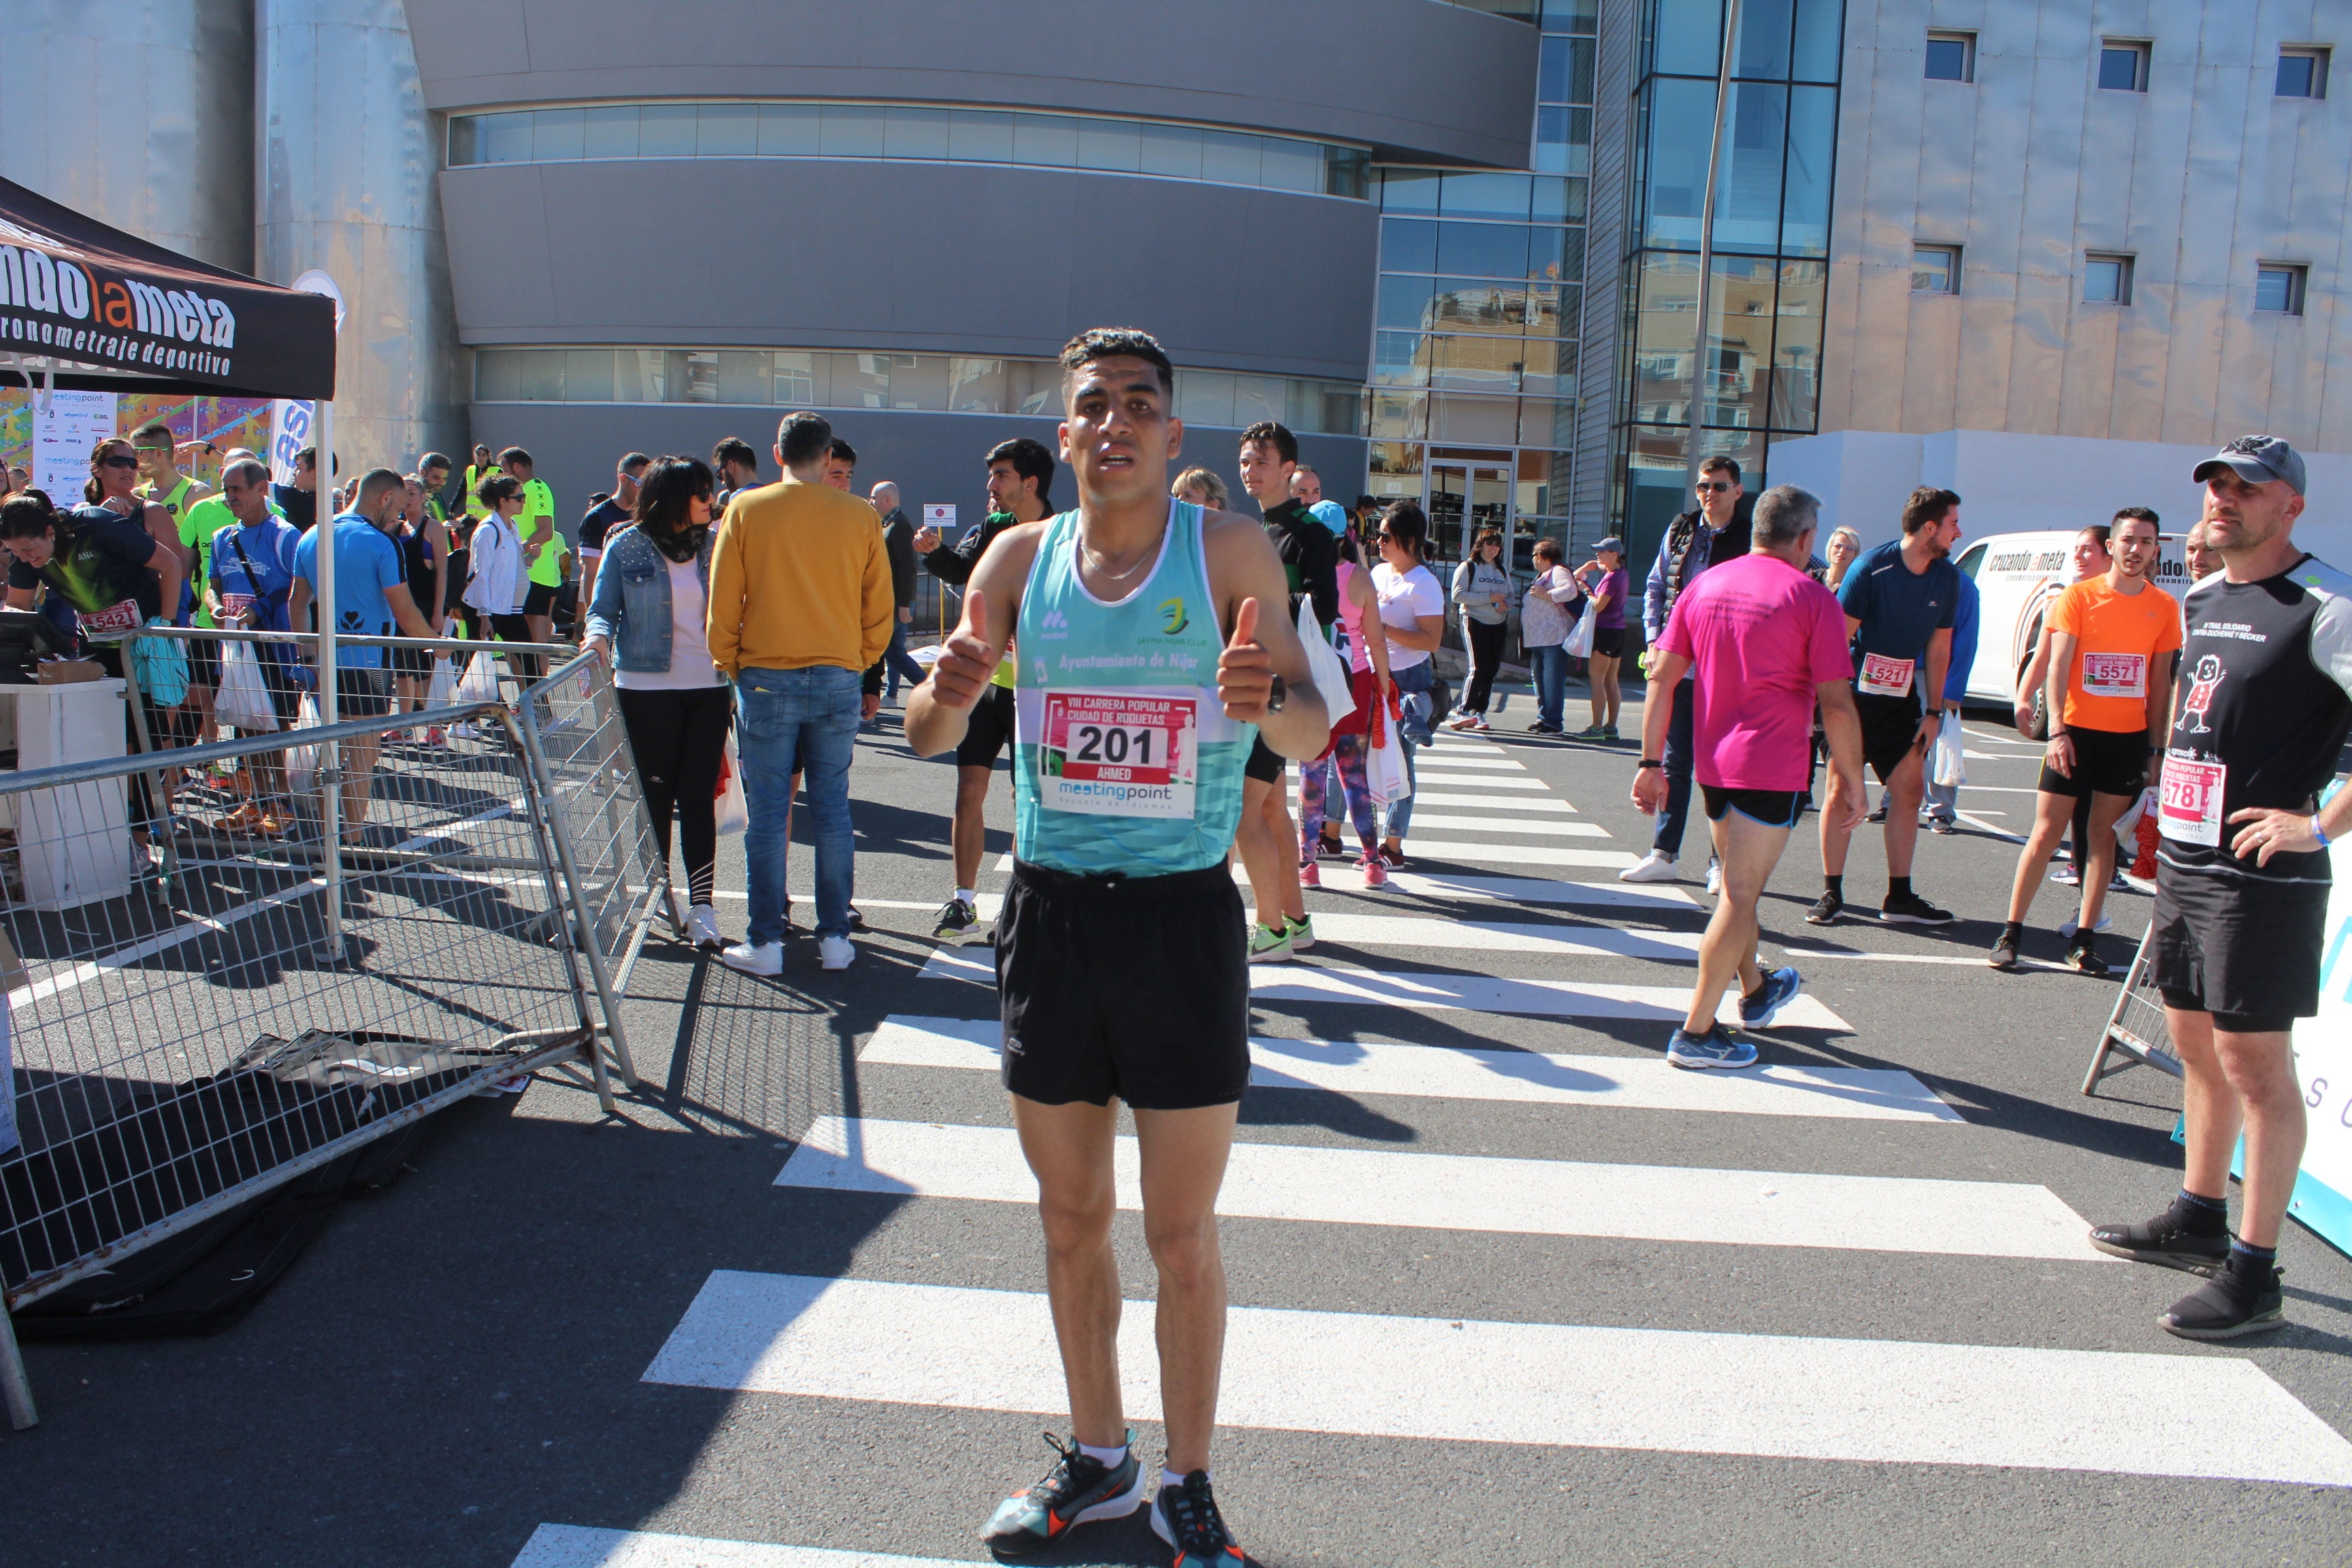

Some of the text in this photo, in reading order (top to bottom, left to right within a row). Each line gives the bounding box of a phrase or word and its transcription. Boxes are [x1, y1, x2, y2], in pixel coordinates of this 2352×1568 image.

[142, 342, 231, 376] deportivo
[52, 393, 104, 402] eetingpoint
[78, 551, 95, 561] ANA
[96, 614, 127, 627] 542
[2222, 623, 2252, 632] SOLIDARIO
[2238, 632, 2266, 642] BECKER
[1060, 653, 1146, 673] Ayuntamiento
[1149, 651, 1165, 667] de
[1876, 668, 1900, 681] 521
[2100, 666, 2130, 679] 557
[1068, 697, 1171, 713] VIII CARRERA POPULAR
[1067, 710, 1165, 725] CIUDAD DE ROQUETAS
[1077, 725, 1151, 764] 201
[1097, 766, 1132, 781] AHMED
[2180, 764, 2205, 774] POPULAR
[1060, 783, 1172, 800] meetingpoint
[2164, 780, 2195, 808] 678
[1059, 797, 1100, 806] Escuela
